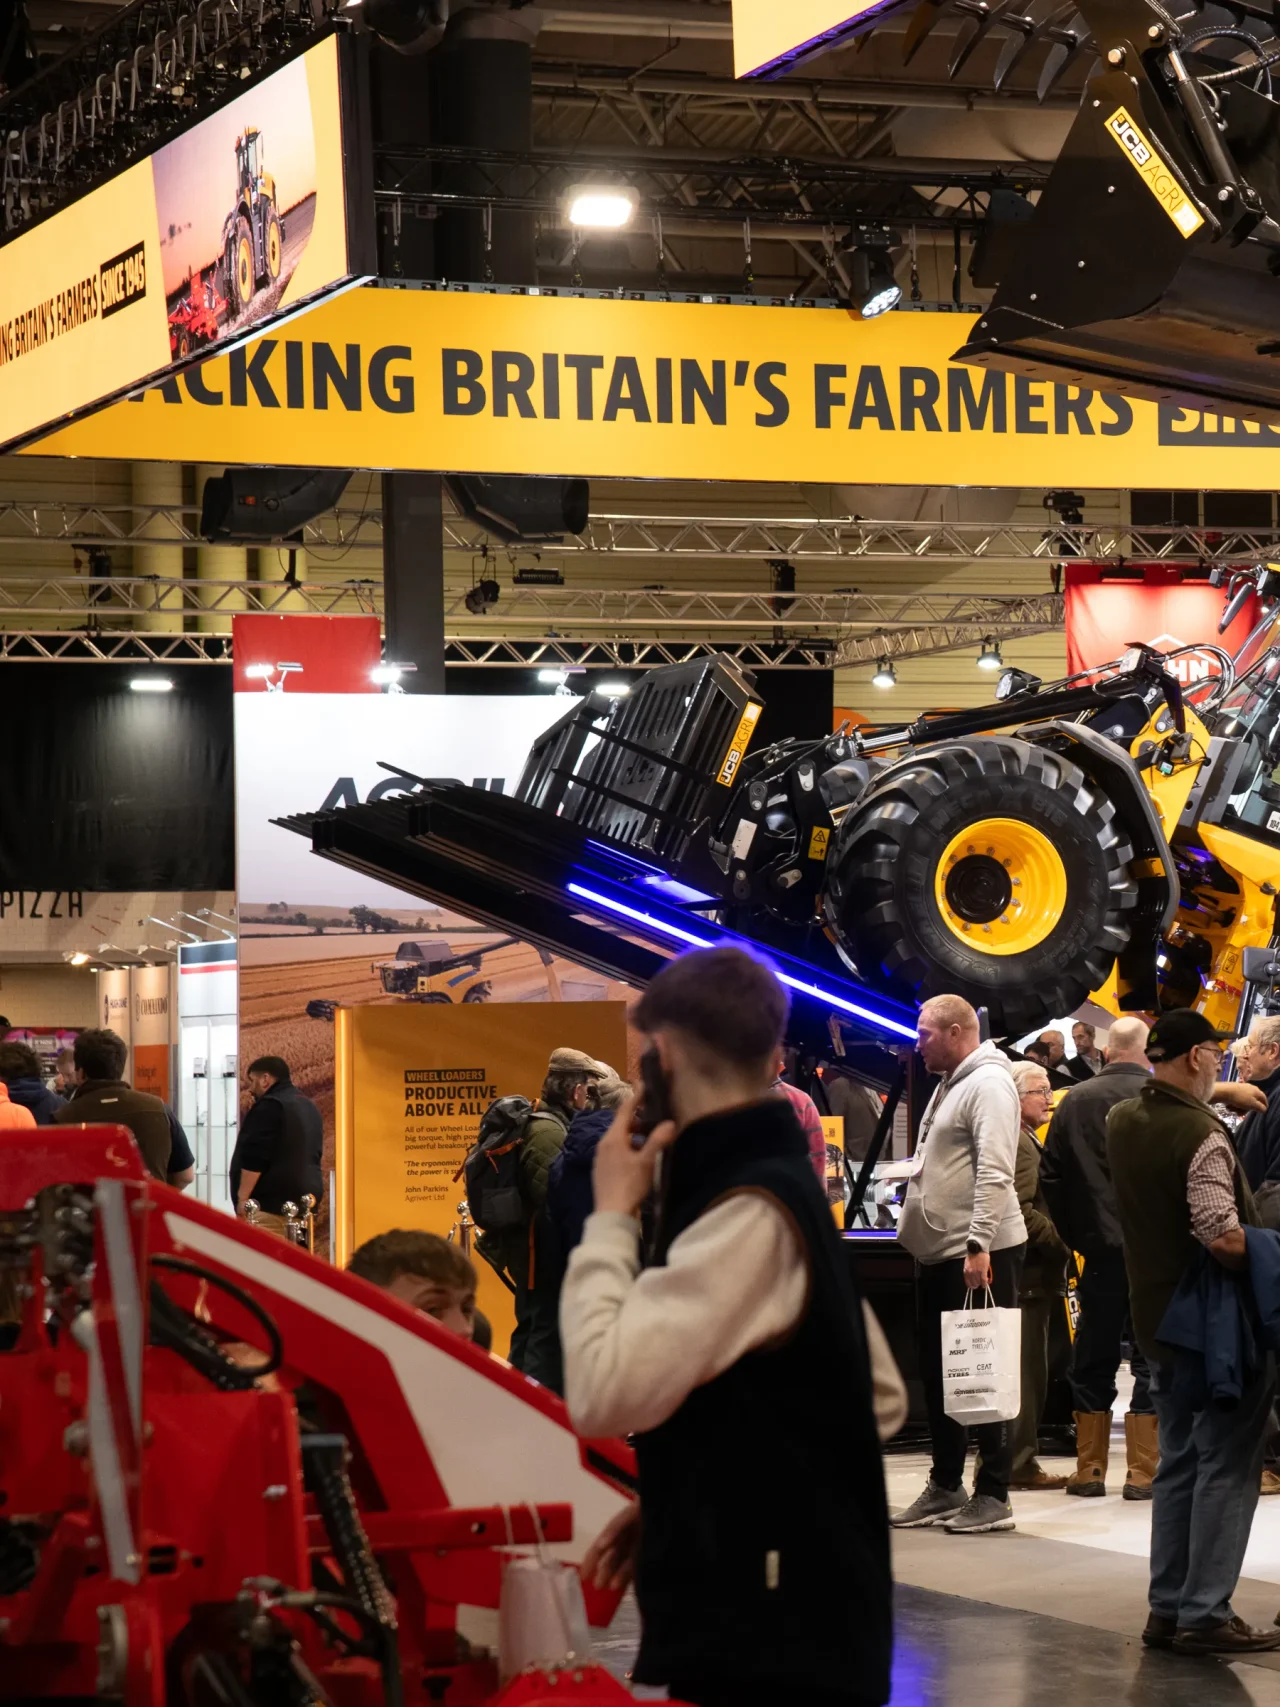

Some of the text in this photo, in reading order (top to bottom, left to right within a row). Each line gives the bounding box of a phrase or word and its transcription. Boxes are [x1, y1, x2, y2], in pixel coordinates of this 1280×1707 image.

[1111, 119, 1184, 212] JCB AGRI
[15, 298, 54, 358] BRITAIN'S
[57, 274, 97, 336] FARMERS
[101, 262, 125, 310] SINCE
[125, 250, 145, 298] 1945
[128, 339, 415, 414] CKING
[442, 349, 789, 427] BRITAIN'S
[814, 363, 1134, 436] FARMERS
[1162, 659, 1210, 682] HN
[723, 719, 754, 784] JCB AGRI
[0, 891, 83, 919] PIZZA
[406, 1070, 483, 1082] WHEEL LOADERS
[405, 1085, 498, 1101] PRODUCTIVE
[405, 1102, 485, 1117] ABOVE ALL
[405, 1143, 436, 1151] powerful
[421, 1160, 462, 1168] ergonomics
[423, 1185, 449, 1193] Parkins
[976, 1363, 992, 1371] CEAT
